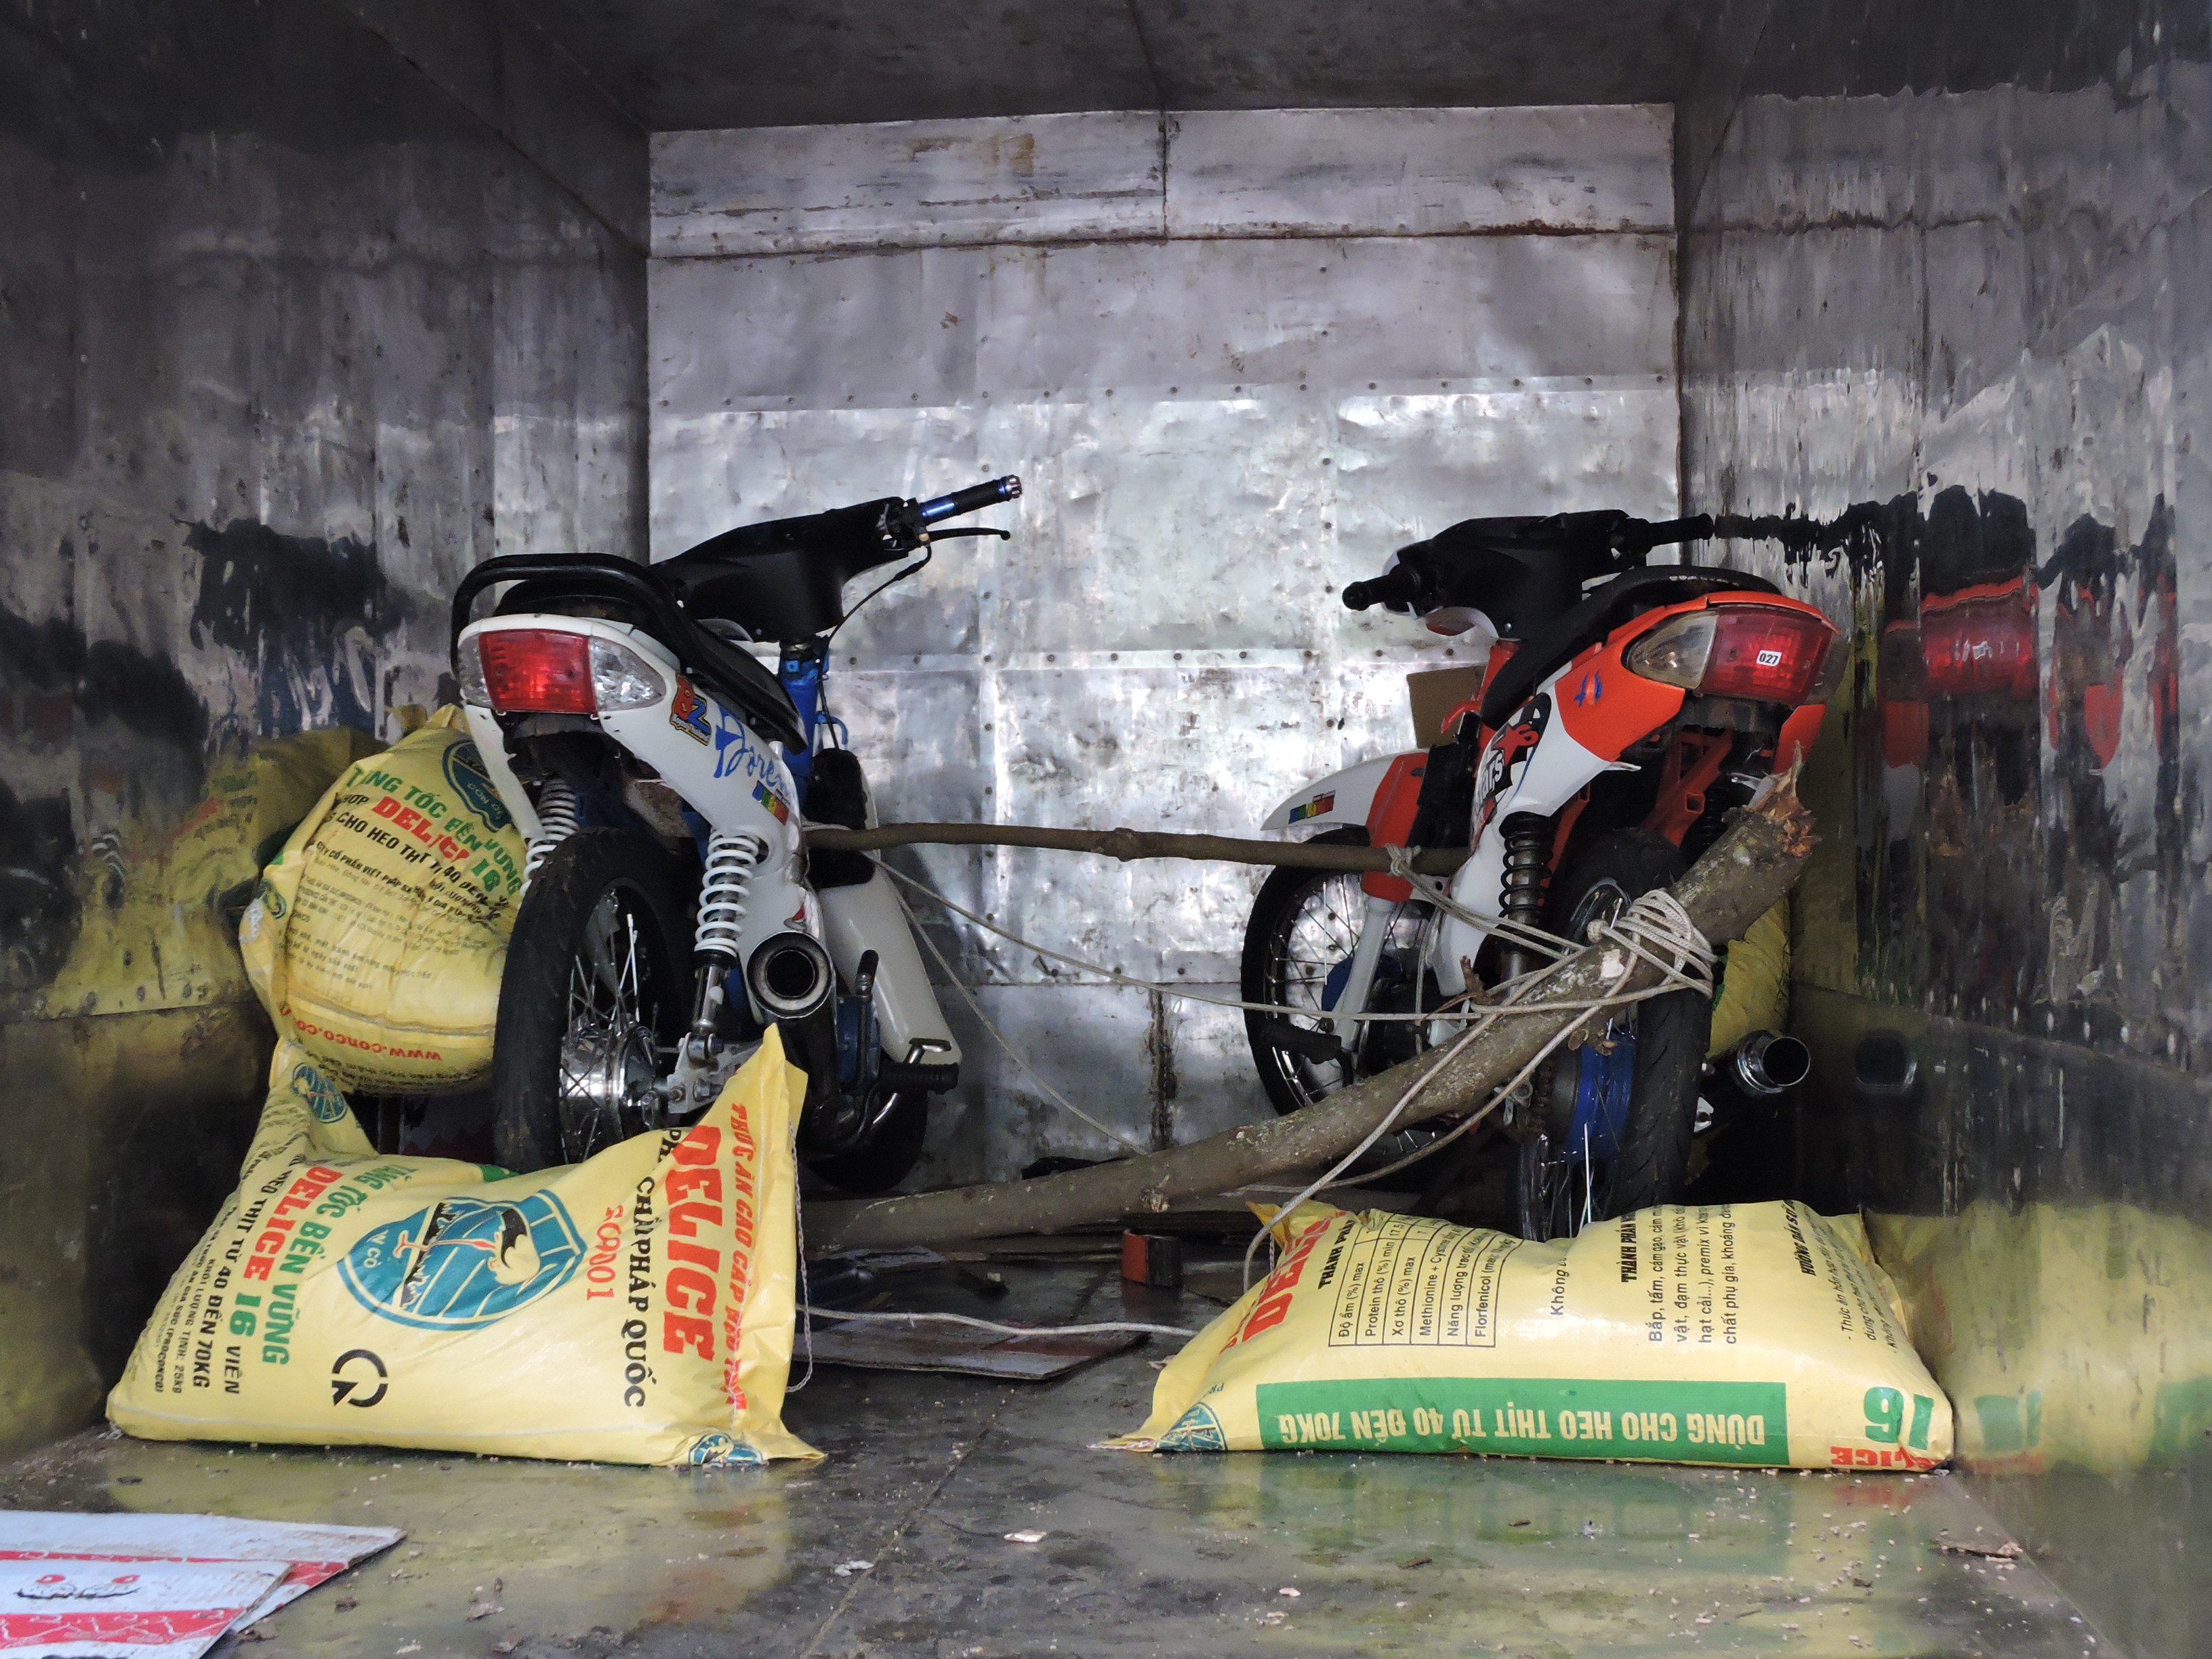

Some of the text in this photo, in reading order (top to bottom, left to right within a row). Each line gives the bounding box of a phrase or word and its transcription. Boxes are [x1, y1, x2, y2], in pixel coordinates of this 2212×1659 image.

[1759, 653, 1779, 665] 027
[404, 785, 447, 819] TỐC
[337, 812, 368, 834] CHO
[367, 826, 400, 850] HEO
[316, 1185, 368, 1219] TỐC
[244, 1167, 345, 1282] DELICE
[735, 1198, 753, 1248] CAO
[1648, 1217, 1662, 1233] cám
[224, 1238, 244, 1263] TỪ
[279, 1221, 332, 1274] BỀN
[663, 1125, 724, 1362] DELICE
[1380, 1241, 1395, 1257] min
[1673, 1234, 1689, 1249] vật
[1698, 1239, 1715, 1275] premix
[1719, 1221, 1738, 1260] khoáng
[213, 1265, 232, 1289] 40
[628, 1238, 657, 1313] PHÁP
[1317, 1245, 1344, 1290] THÀNH
[1375, 1258, 1393, 1275] (%)
[1402, 1256, 1416, 1276] max
[1616, 1246, 1637, 1283] THÀNH
[1649, 1253, 1664, 1272] cám
[1673, 1252, 1689, 1277] thực
[1722, 1262, 1740, 1283] gia,
[1338, 1261, 1365, 1338] Độ ẩm (%) max
[1372, 1277, 1385, 1294] thô
[1396, 1277, 1413, 1296] (%)
[1449, 1271, 1469, 1301] lượng
[1551, 1269, 1570, 1315] Không
[1648, 1276, 1664, 1304] tấm,
[1673, 1282, 1689, 1309] đạm
[1697, 1279, 1715, 1315] cải...),
[1722, 1286, 1740, 1309] phụ
[170, 1305, 185, 1326] SÚC
[198, 1294, 225, 1335] ĐẾN
[230, 1292, 261, 1336] 16
[1365, 1296, 1383, 1338] Protein
[1394, 1298, 1408, 1317] thô
[1419, 1274, 1438, 1337] Methionine
[1447, 1304, 1464, 1338] Năng
[1474, 1275, 1492, 1338] Florfenicol
[1838, 1307, 1854, 1332] Thức
[1855, 1298, 1870, 1315] cho
[262, 1284, 300, 1365] VỮNG
[1391, 1319, 1405, 1336] Xơ
[1645, 1308, 1666, 1343] Bắp,
[1673, 1314, 1689, 1343] vật,
[1698, 1319, 1713, 1343] hạt
[1721, 1312, 1738, 1345] chất
[1863, 1316, 1877, 1342] dùng
[171, 1364, 186, 1395] 25kg
[192, 1338, 215, 1389] 70KG
[224, 1345, 243, 1395] VIÊN
[621, 1318, 657, 1408] QUỐC
[1277, 1401, 1765, 1451] DÙNG CHO HEO THỊT TỪ 40 ĐẾN 70KG
[1863, 1387, 1935, 1451] 16
